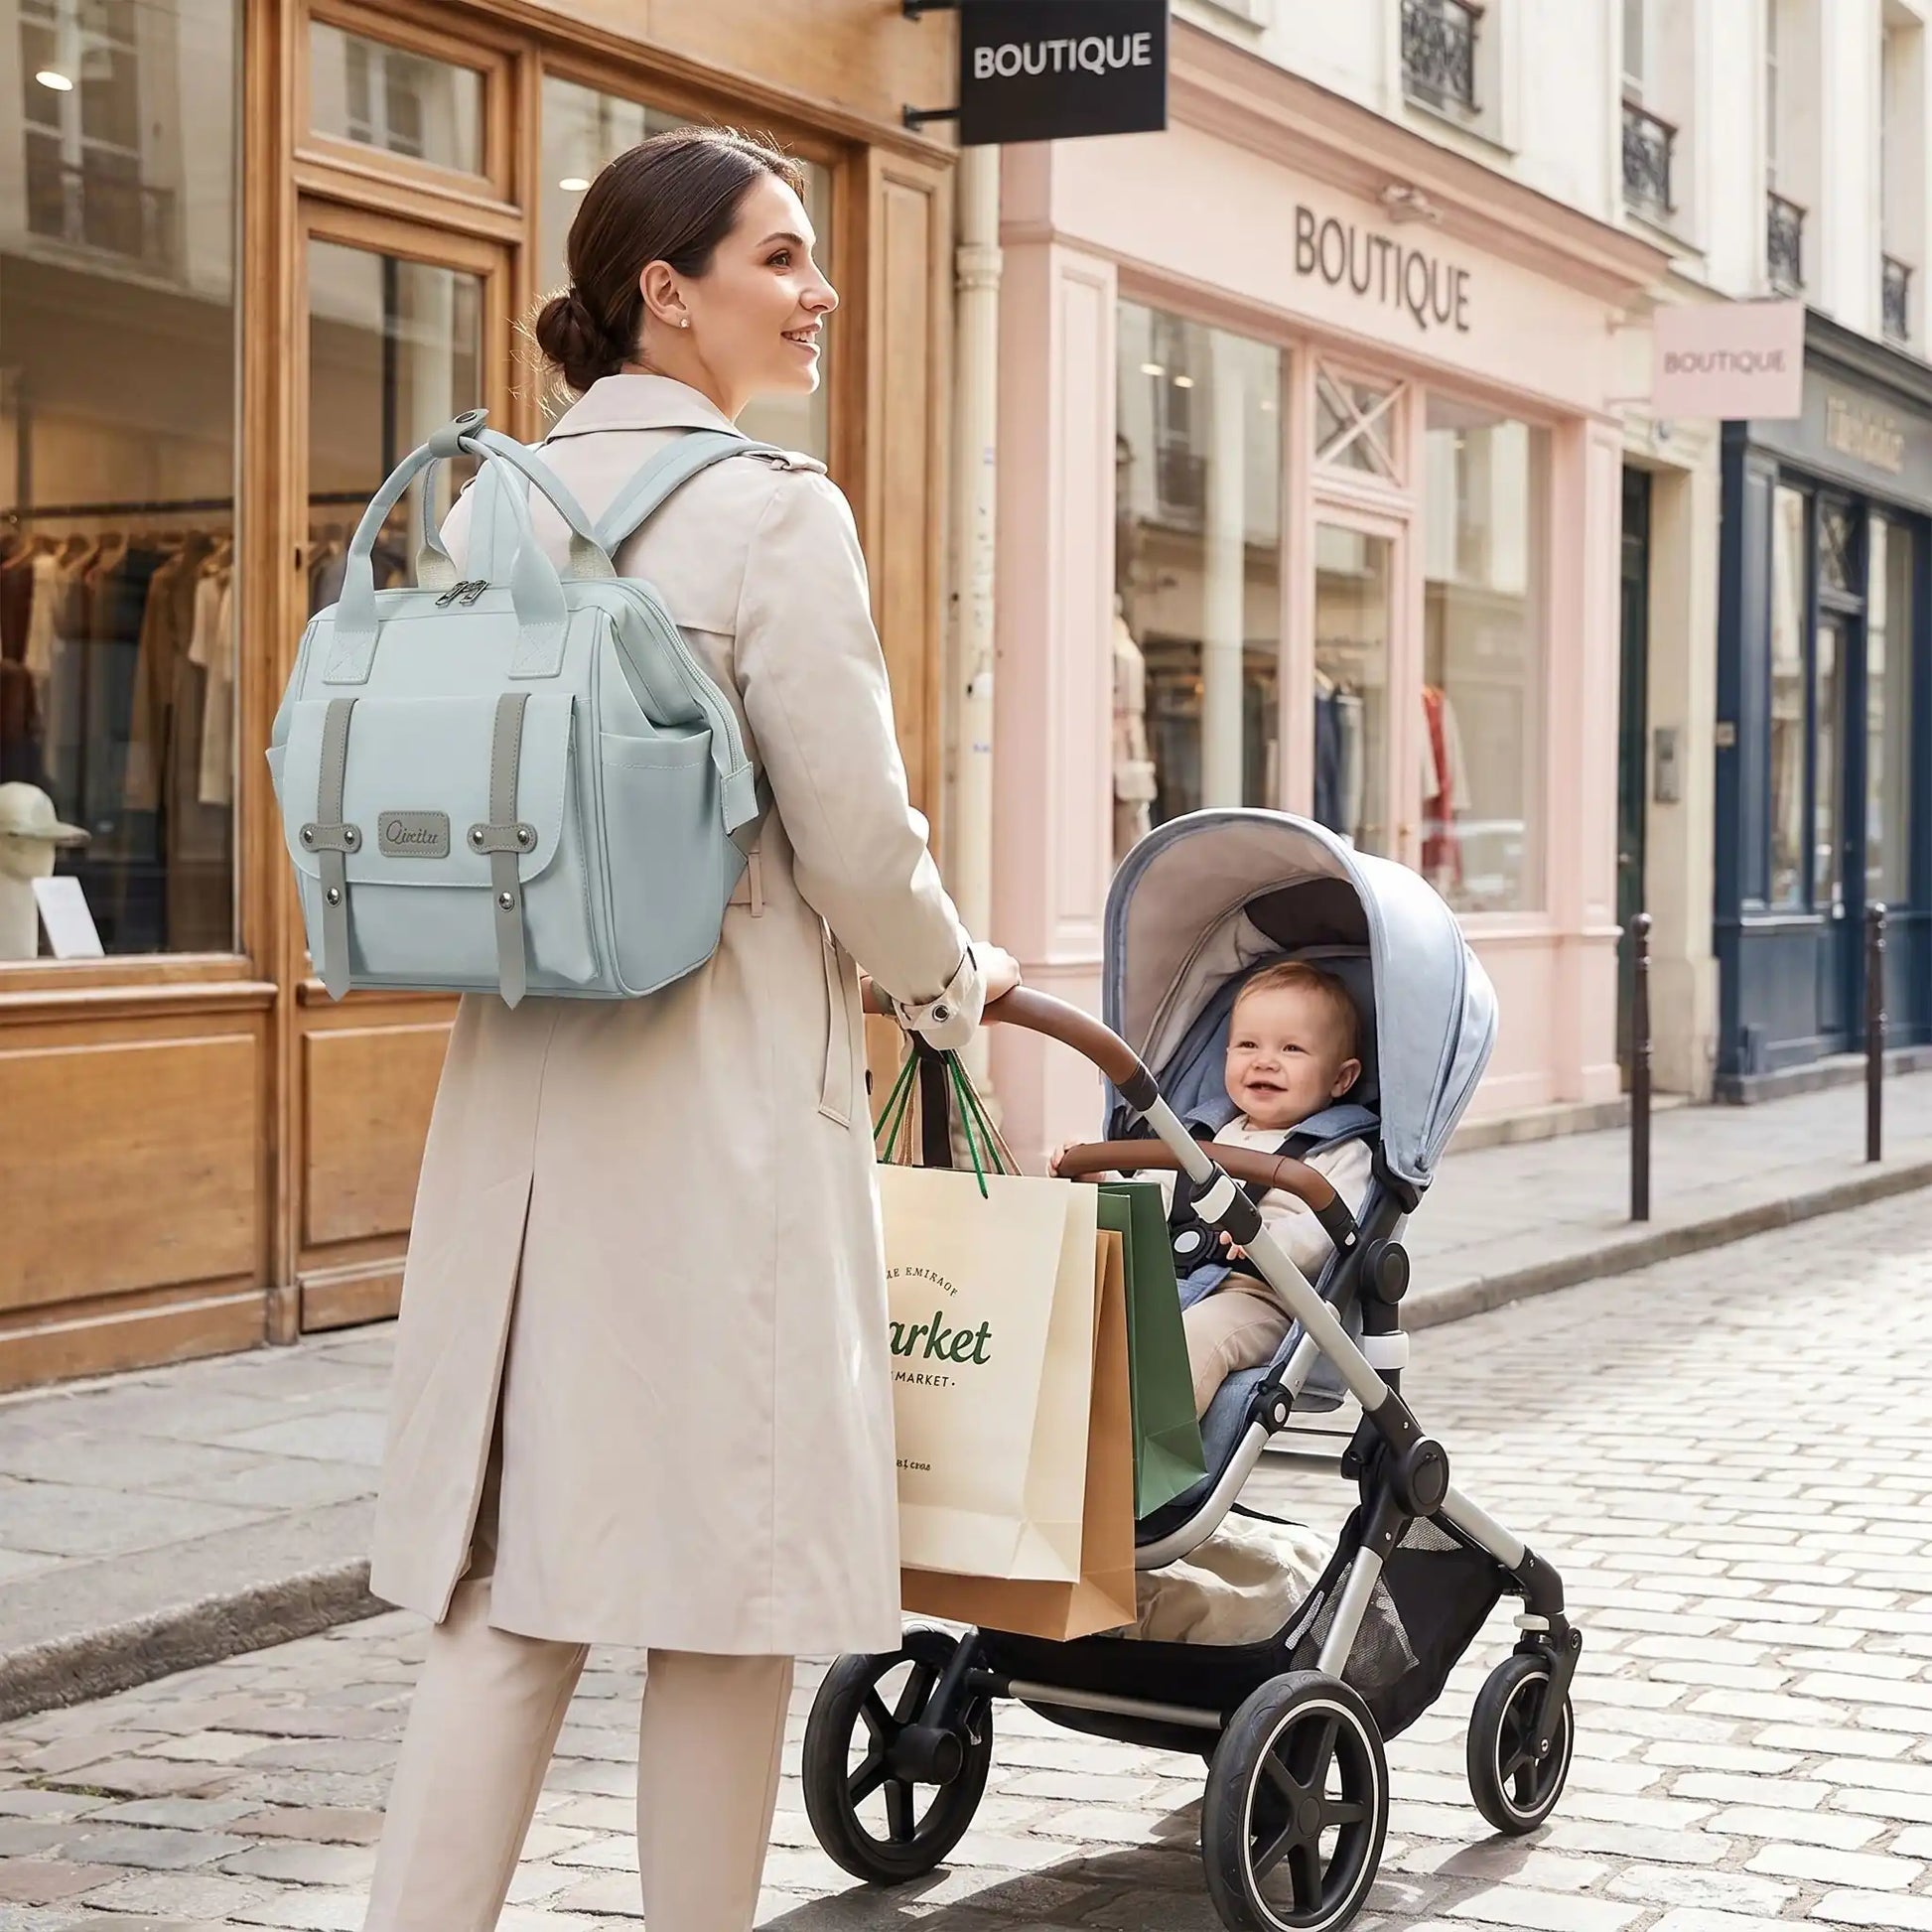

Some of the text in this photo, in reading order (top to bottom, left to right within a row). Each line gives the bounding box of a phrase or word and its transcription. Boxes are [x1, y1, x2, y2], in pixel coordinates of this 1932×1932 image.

[973, 32, 1152, 79] BOUTIQUE
[1295, 205, 1470, 332] BOUTIQUE
[1664, 349, 1786, 374] BOUTIQUE
